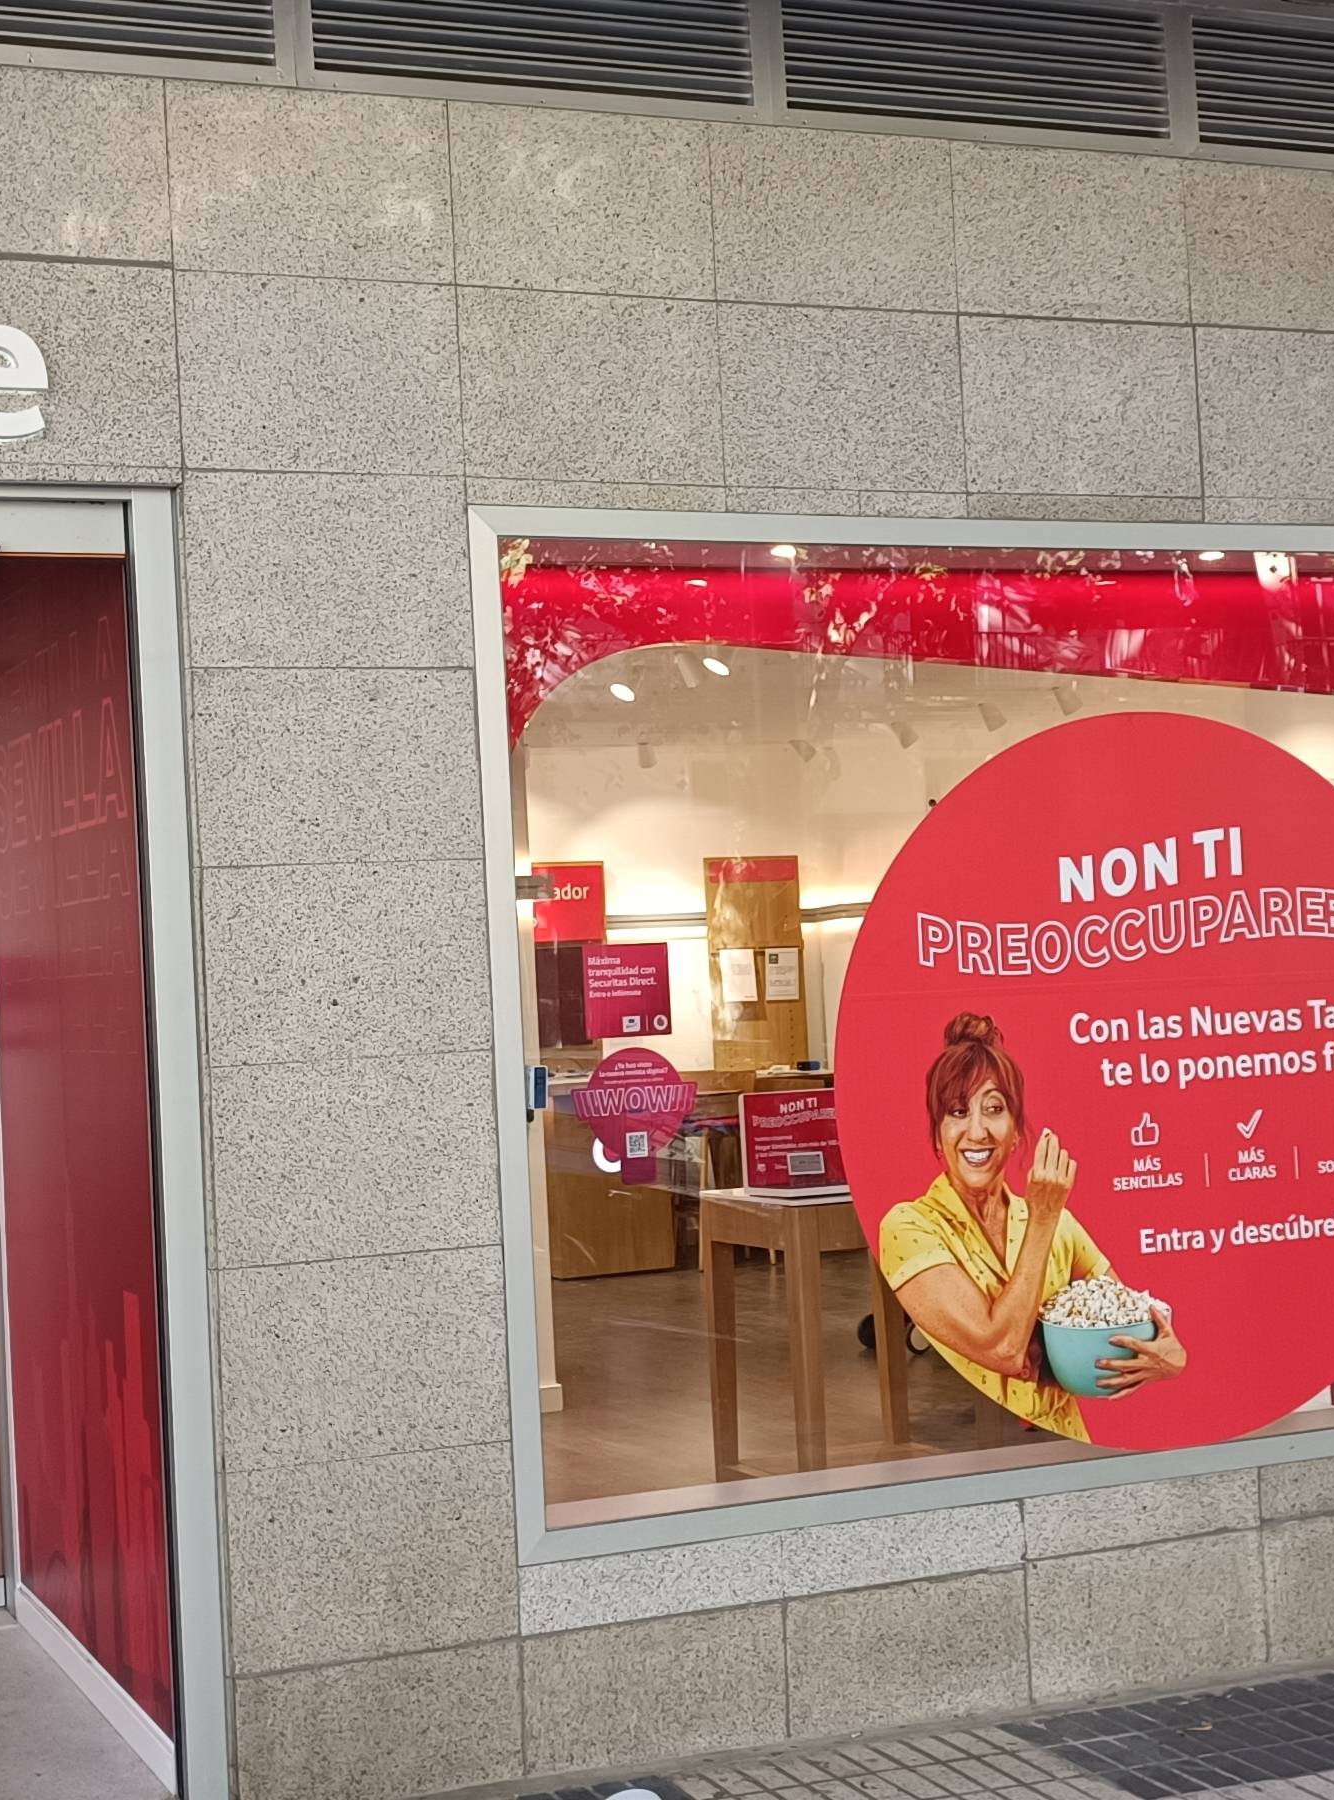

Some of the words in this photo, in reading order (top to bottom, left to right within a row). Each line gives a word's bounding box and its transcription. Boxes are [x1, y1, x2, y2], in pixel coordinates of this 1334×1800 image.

[1058, 837, 1178, 904] NON
[1192, 827, 1244, 879] TI
[587, 966, 639, 978] tranquilidad
[640, 967, 656, 975] con
[588, 978, 628, 988] Securitas
[1069, 1013, 1130, 1045] Con
[1137, 1009, 1184, 1041] las
[1190, 1004, 1303, 1038] Nuevas
[1101, 1057, 1133, 1087] te
[1140, 1053, 1170, 1084] lo
[1178, 1050, 1317, 1091] ponemos
[594, 1084, 677, 1117] WOW
[1133, 1155, 1162, 1172] MÁS
[1237, 1146, 1266, 1164] MÁS
[1112, 1172, 1183, 1192] SENCILLAS
[1228, 1163, 1277, 1182] CLARAS
[1139, 1227, 1206, 1254] Entra
[1210, 1230, 1227, 1255] y
